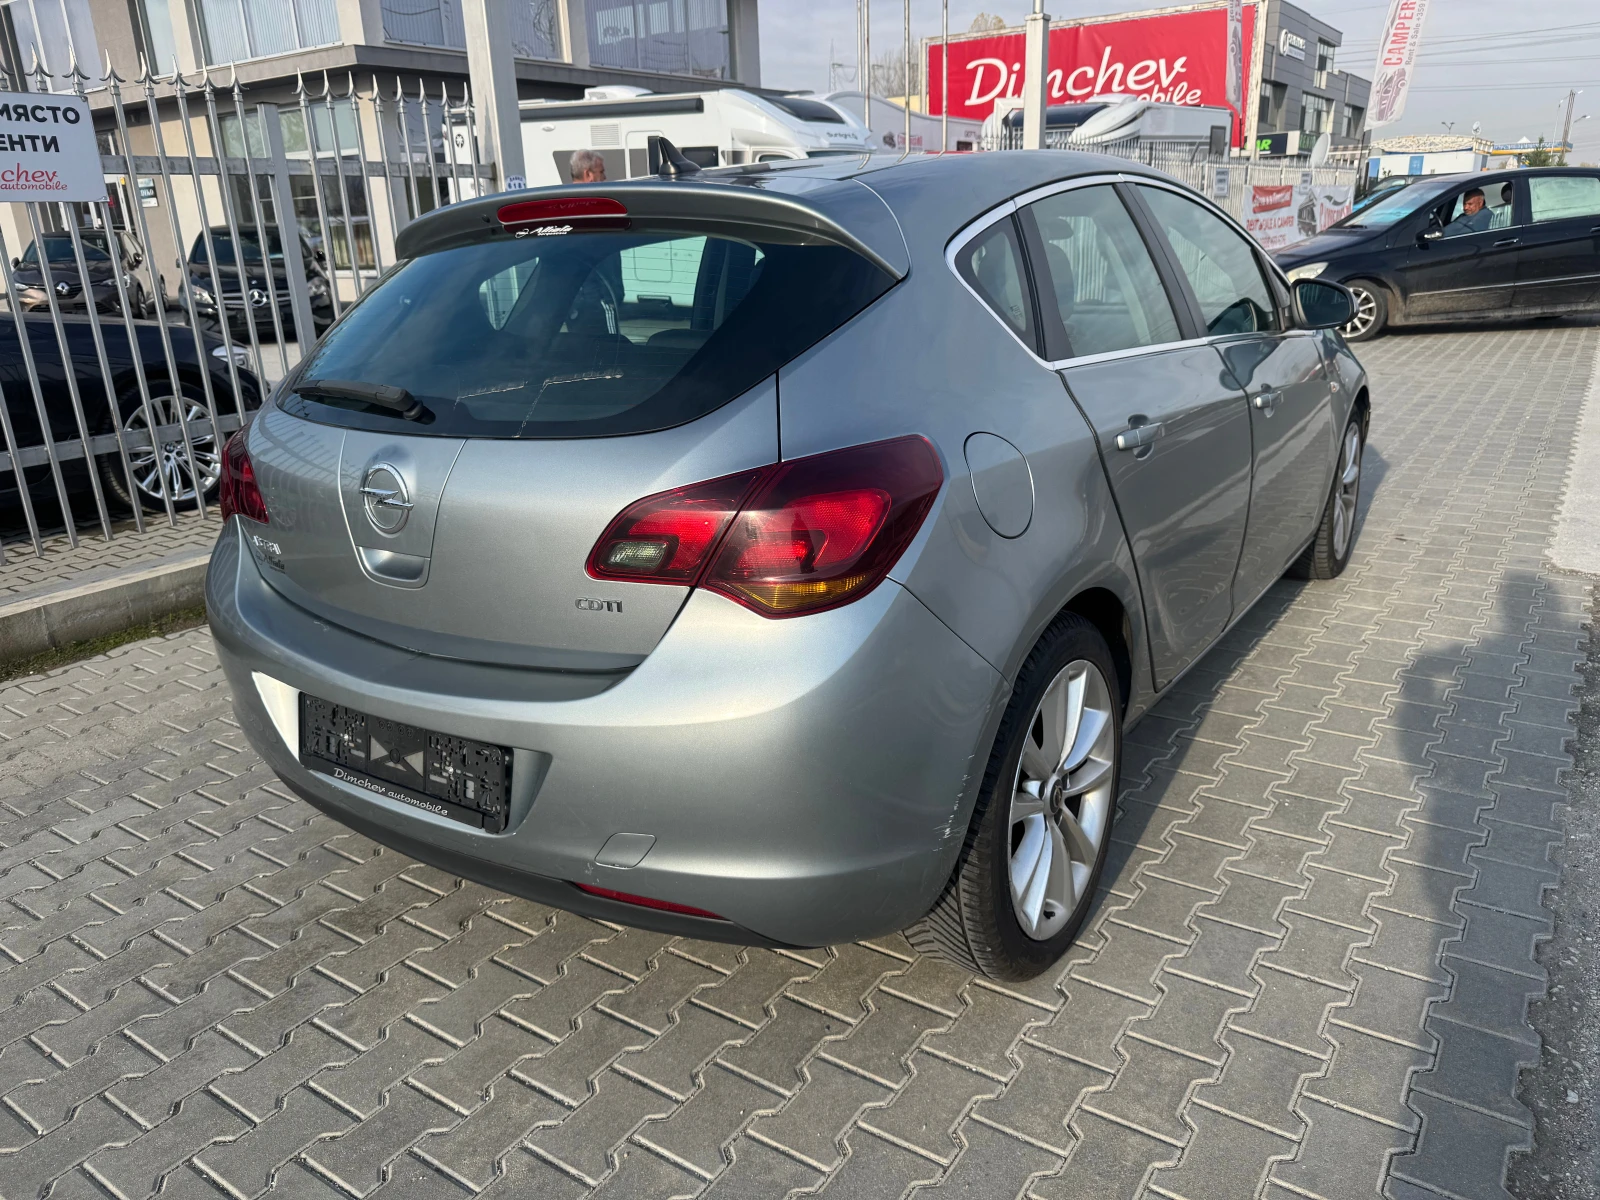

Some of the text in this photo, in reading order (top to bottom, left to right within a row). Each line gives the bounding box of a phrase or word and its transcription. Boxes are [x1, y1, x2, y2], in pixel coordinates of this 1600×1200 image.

[0, 180, 68, 191] automobile
[574, 596, 624, 613] CDTI
[333, 766, 449, 816] Dimchev automobile
